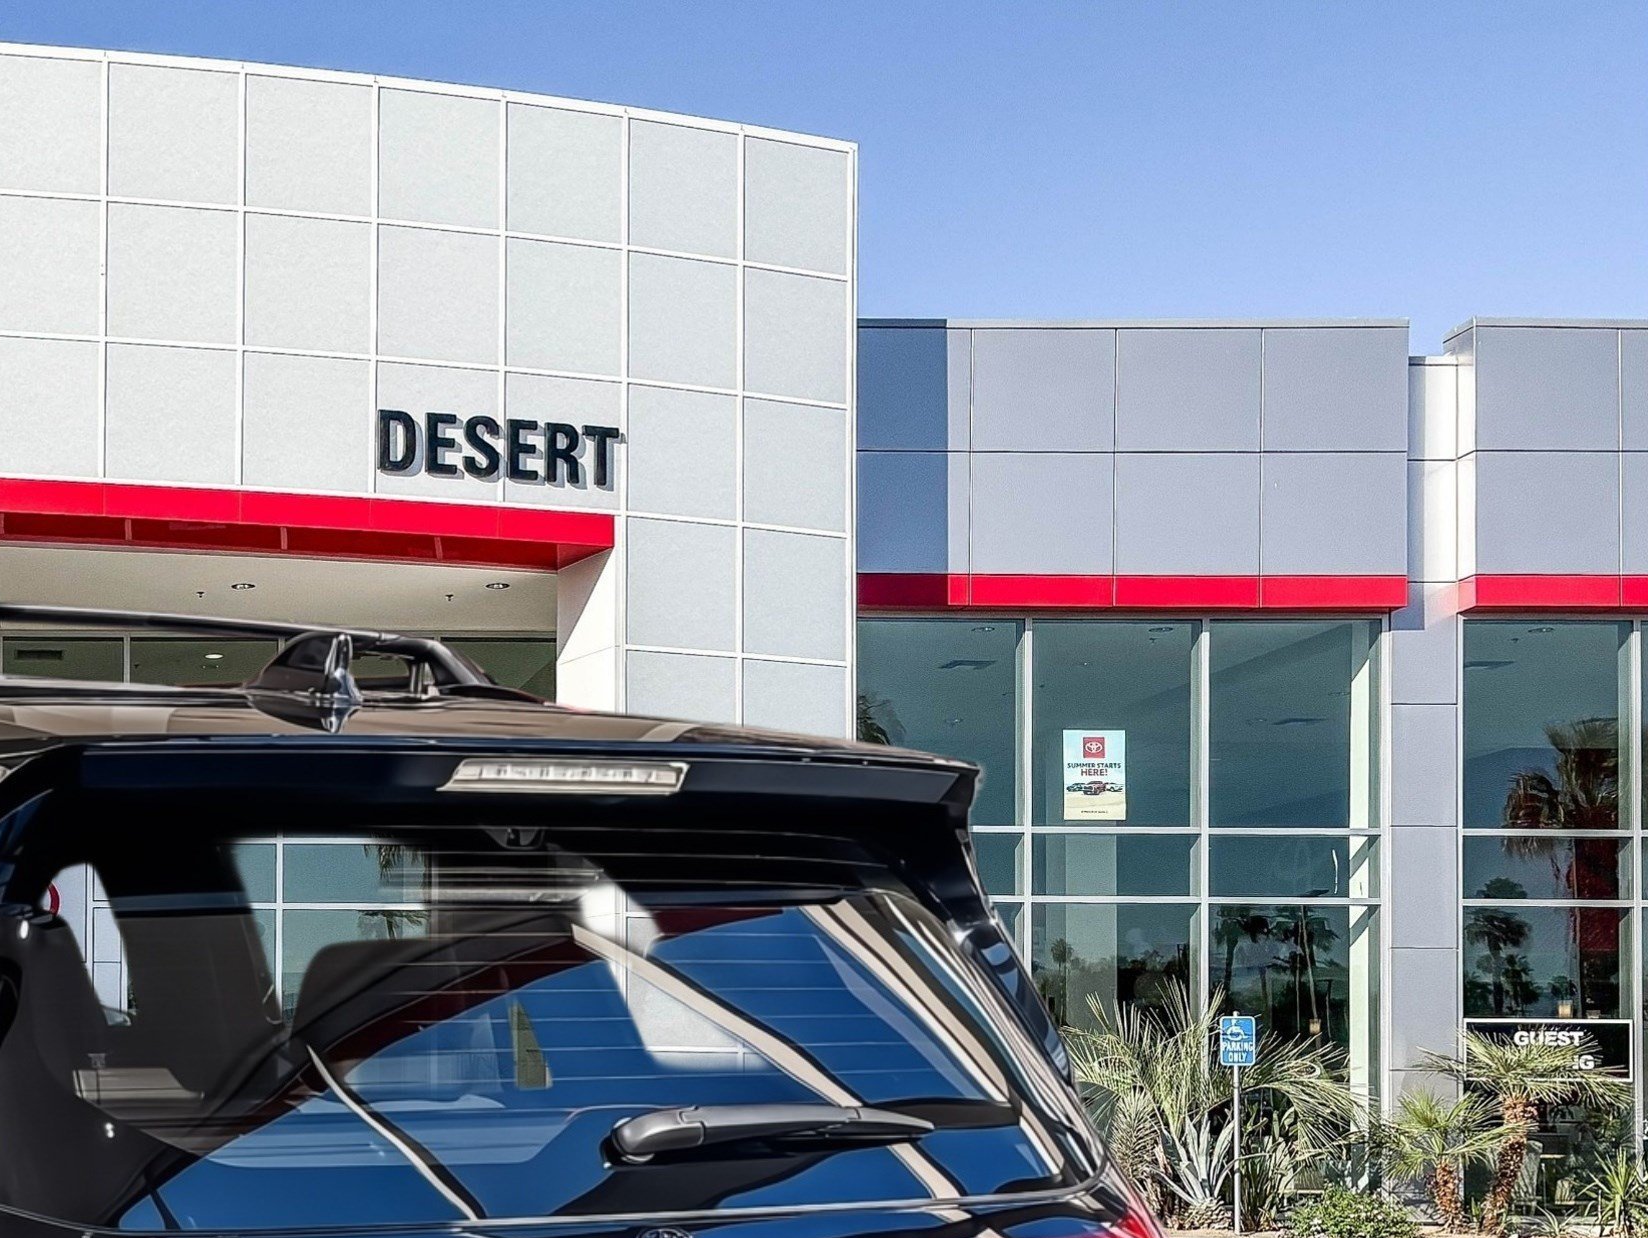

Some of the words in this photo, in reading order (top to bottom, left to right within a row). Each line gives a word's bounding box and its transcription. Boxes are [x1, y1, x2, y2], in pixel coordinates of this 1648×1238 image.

[377, 409, 620, 486] DESERT
[1080, 768, 1108, 777] HERE!
[1513, 1030, 1585, 1047] GUEST
[1222, 1040, 1253, 1052] PARKING
[1228, 1051, 1248, 1063] ONLY
